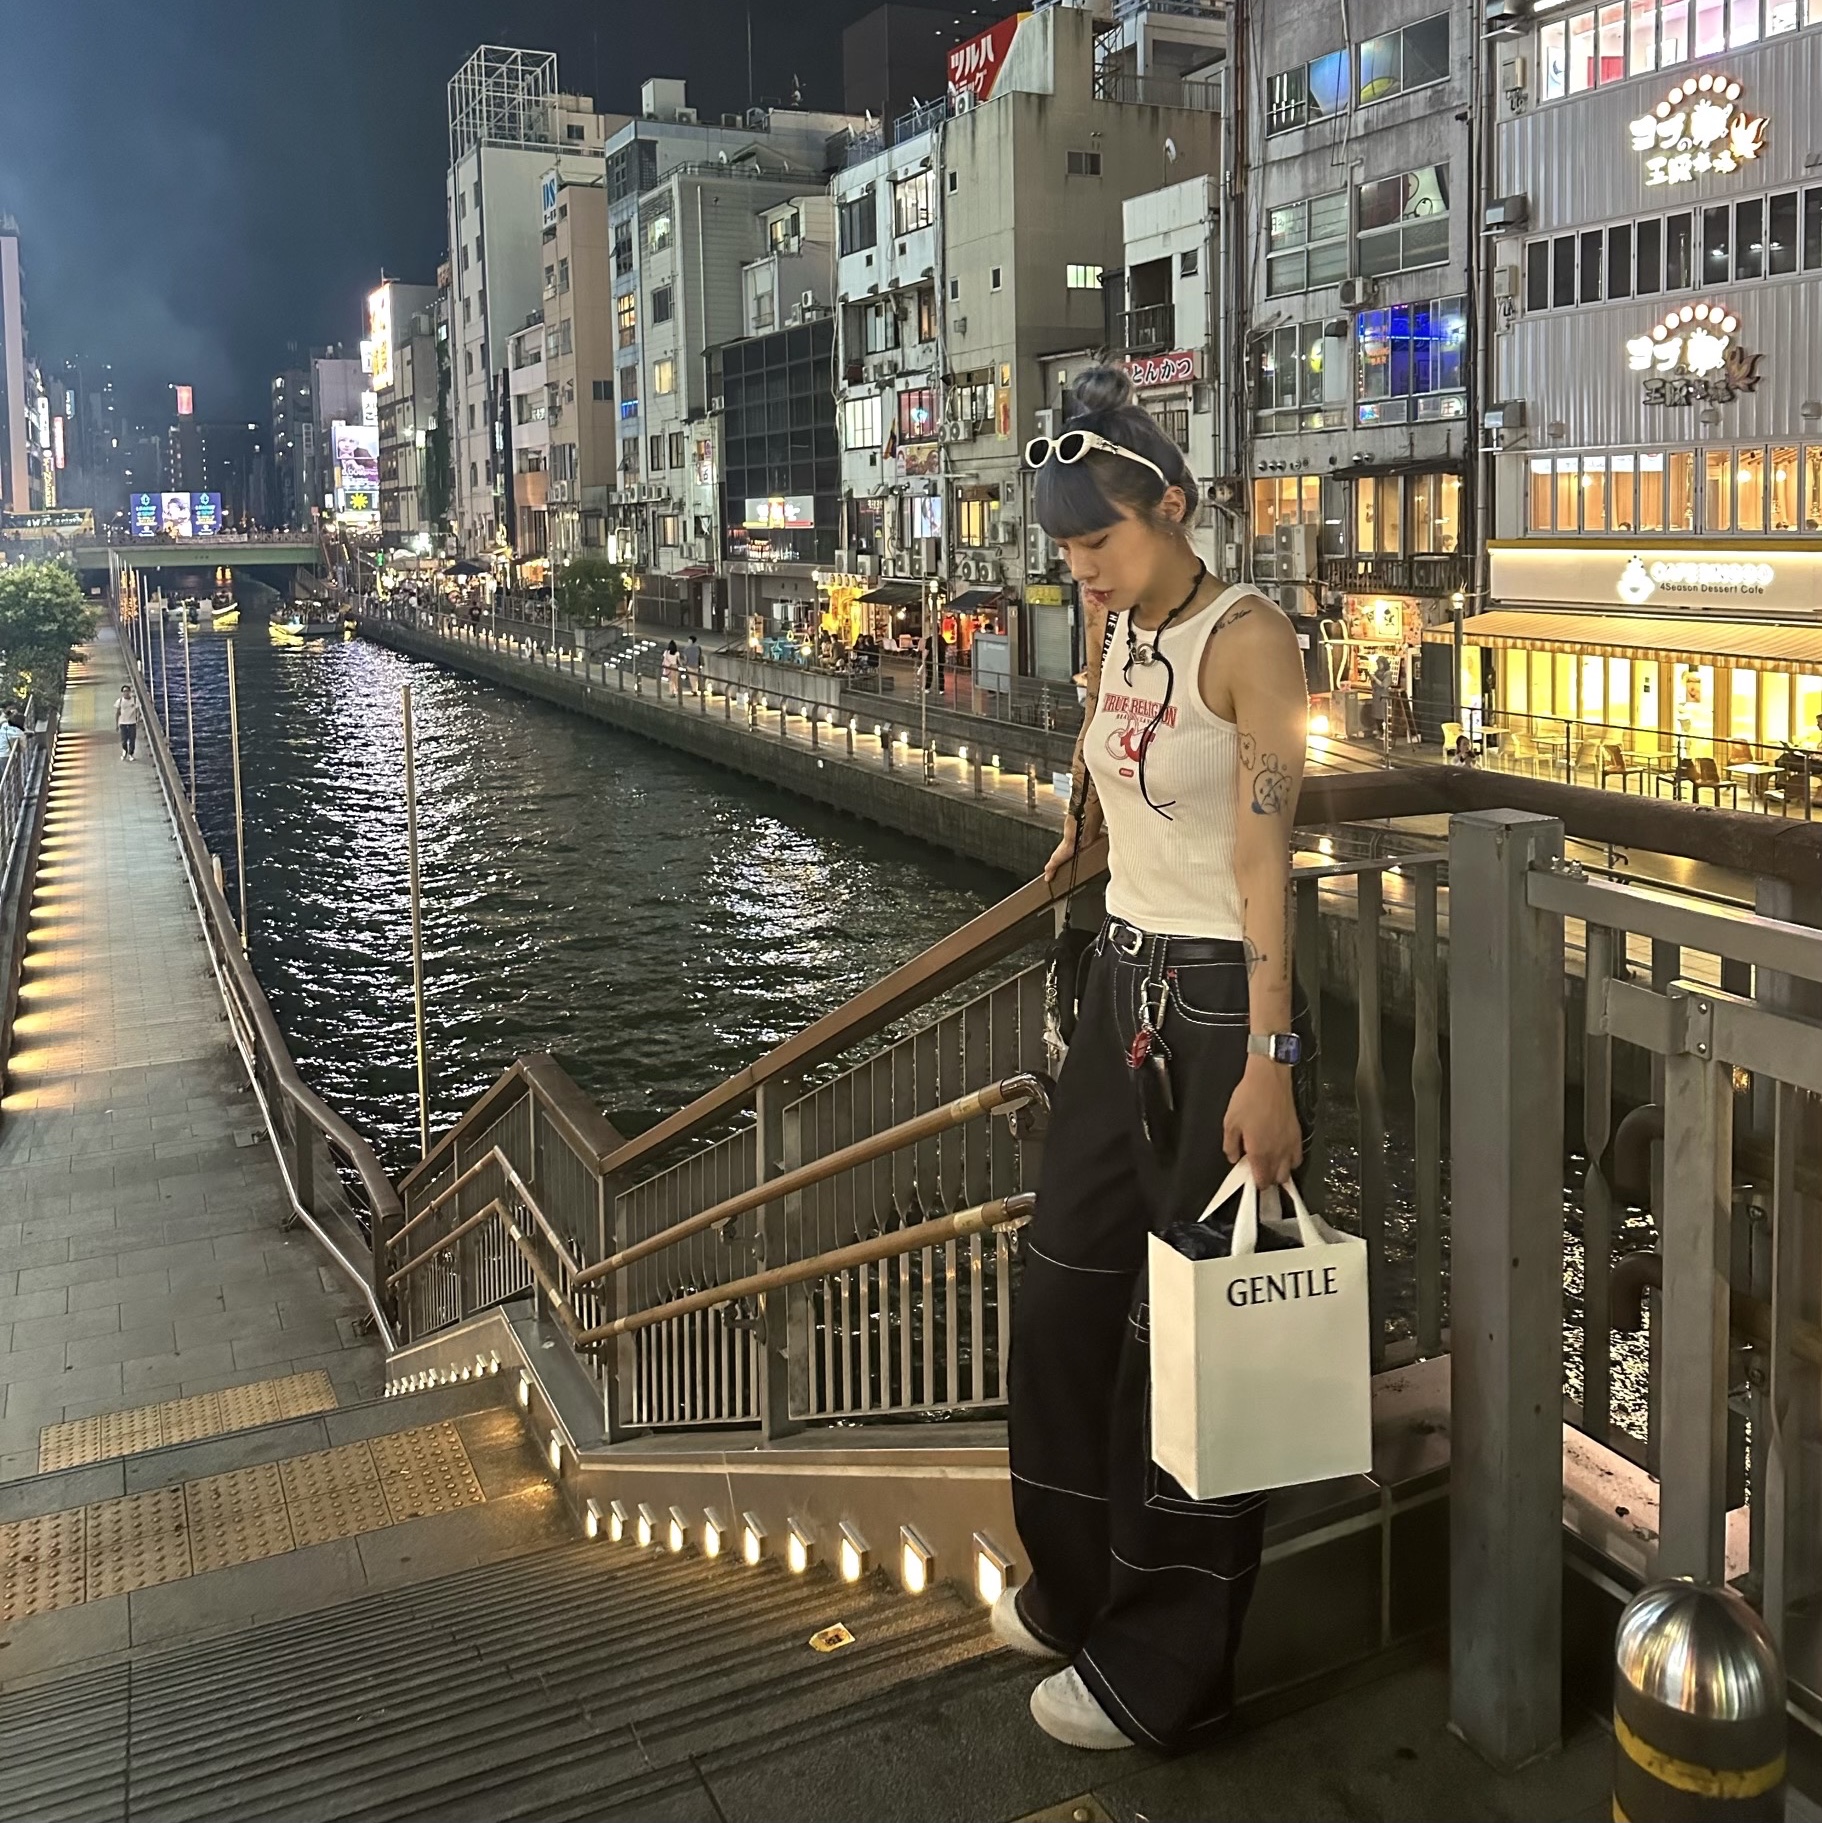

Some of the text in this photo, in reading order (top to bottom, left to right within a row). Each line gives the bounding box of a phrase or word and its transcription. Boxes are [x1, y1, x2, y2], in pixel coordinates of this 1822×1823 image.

[950, 34, 995, 82] ツルハ
[1132, 357, 1193, 386] とんかつ
[1660, 582, 1764, 595] 4Season Dessert Cafe
[1107, 612, 1119, 628] HE
[1102, 692, 1177, 729] TRUE RELIGON
[1227, 1267, 1338, 1307] GENTLE
